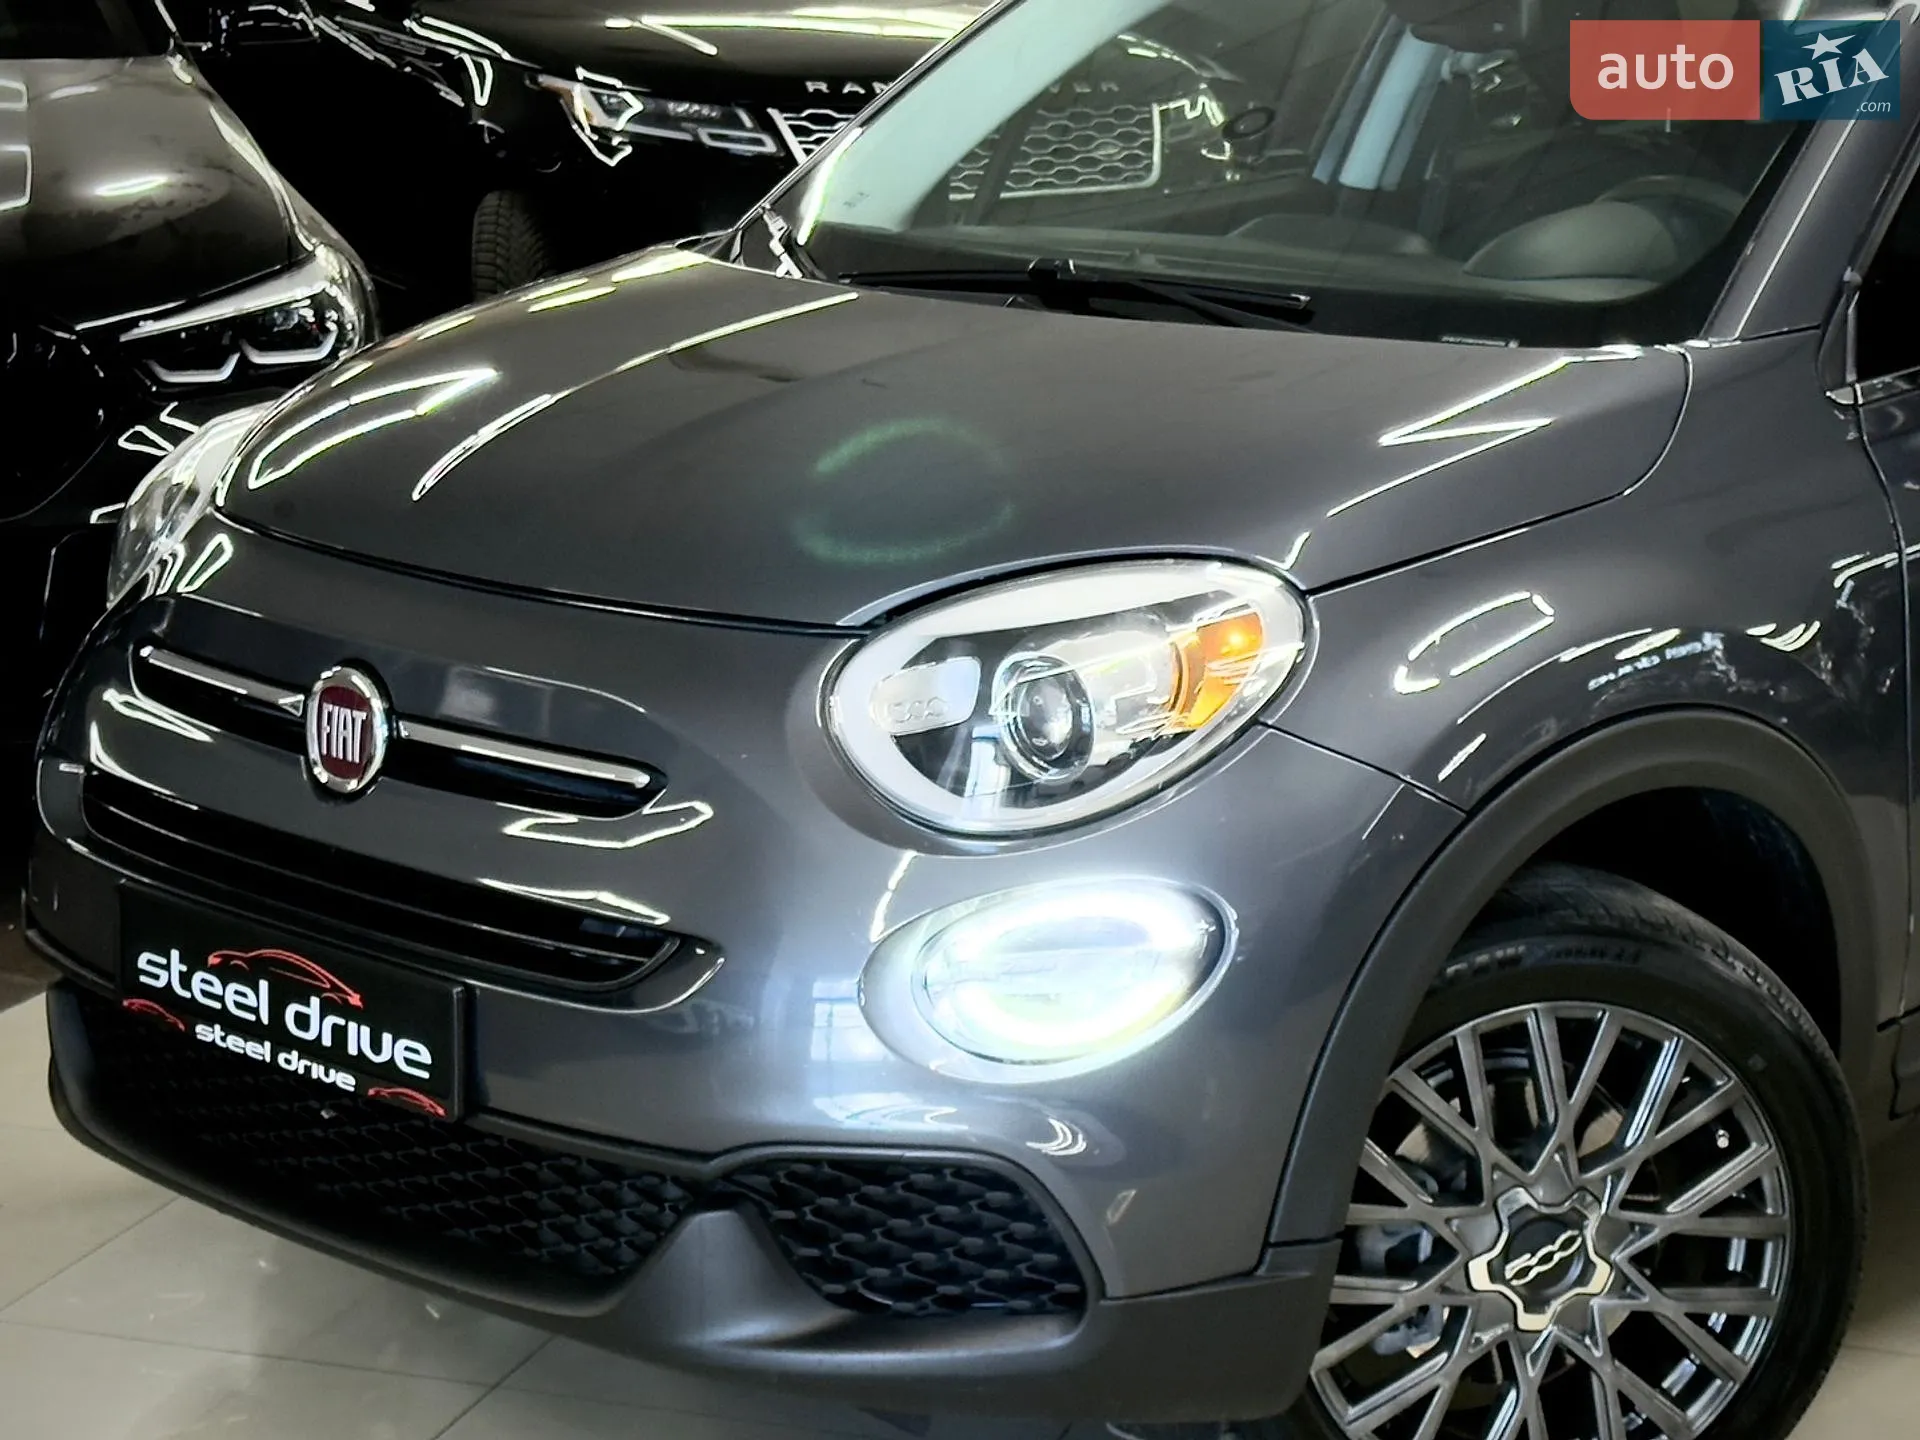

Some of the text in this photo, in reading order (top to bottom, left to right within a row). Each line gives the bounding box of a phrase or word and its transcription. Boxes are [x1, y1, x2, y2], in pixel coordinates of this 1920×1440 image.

[804, 80, 1121, 95] RAN VER
[322, 702, 367, 764] FIAT
[137, 948, 432, 1080] steel drive
[194, 1023, 356, 1092] steel drive
